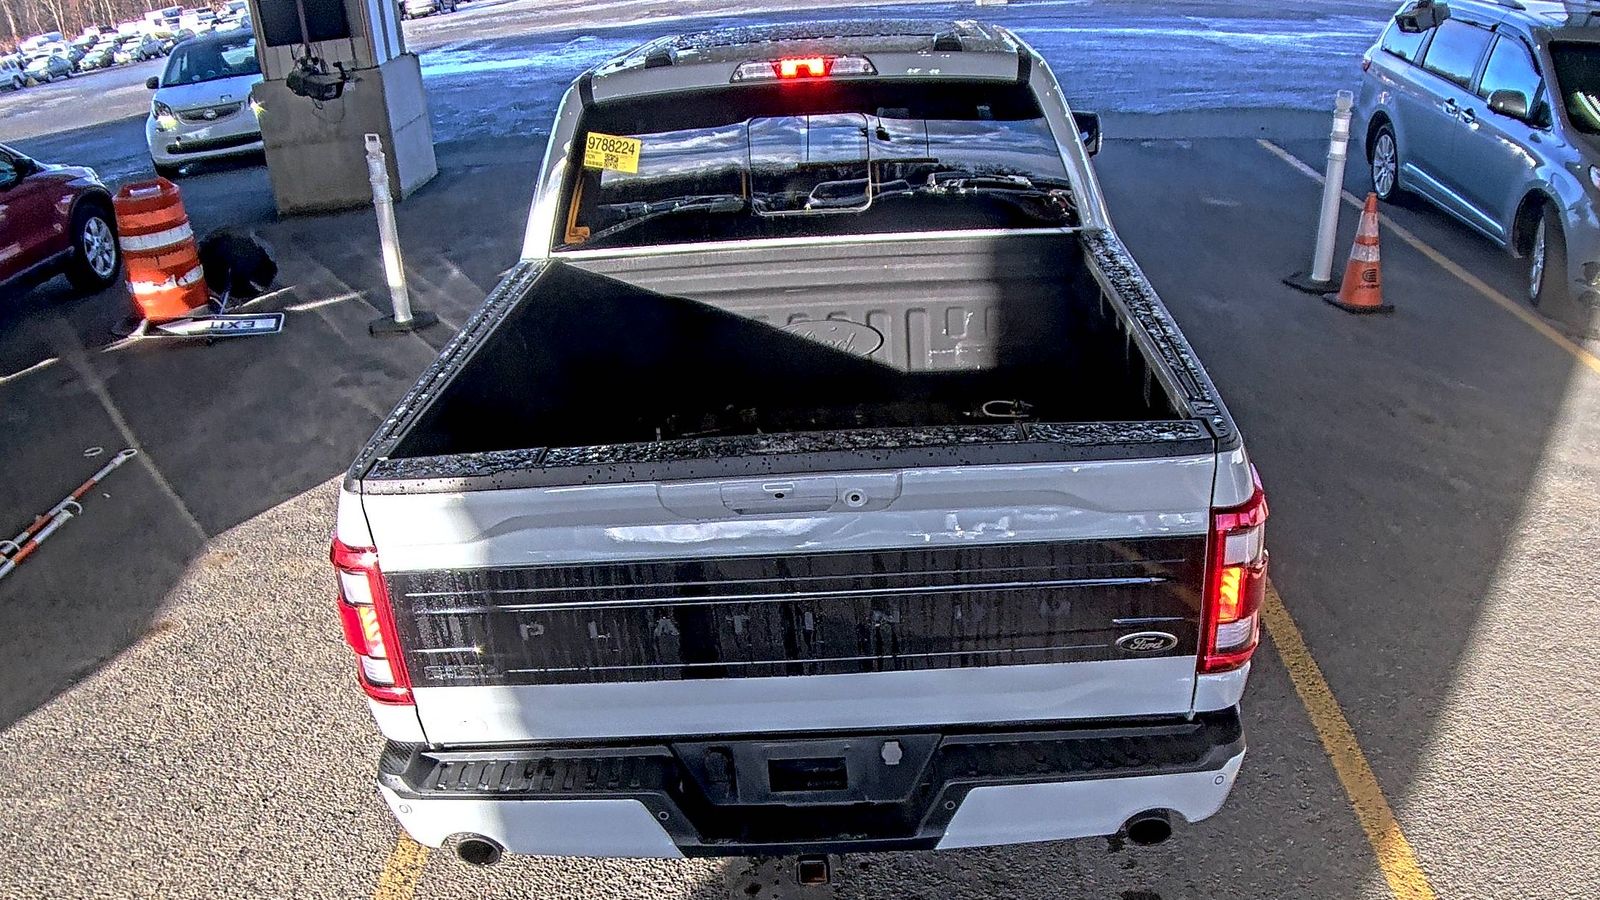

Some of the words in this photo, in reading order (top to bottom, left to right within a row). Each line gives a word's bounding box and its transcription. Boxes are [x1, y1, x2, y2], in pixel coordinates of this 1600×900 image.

[588, 136, 635, 155] 9788224
[211, 320, 255, 329] EXIT
[1129, 636, 1165, 650] Ford
